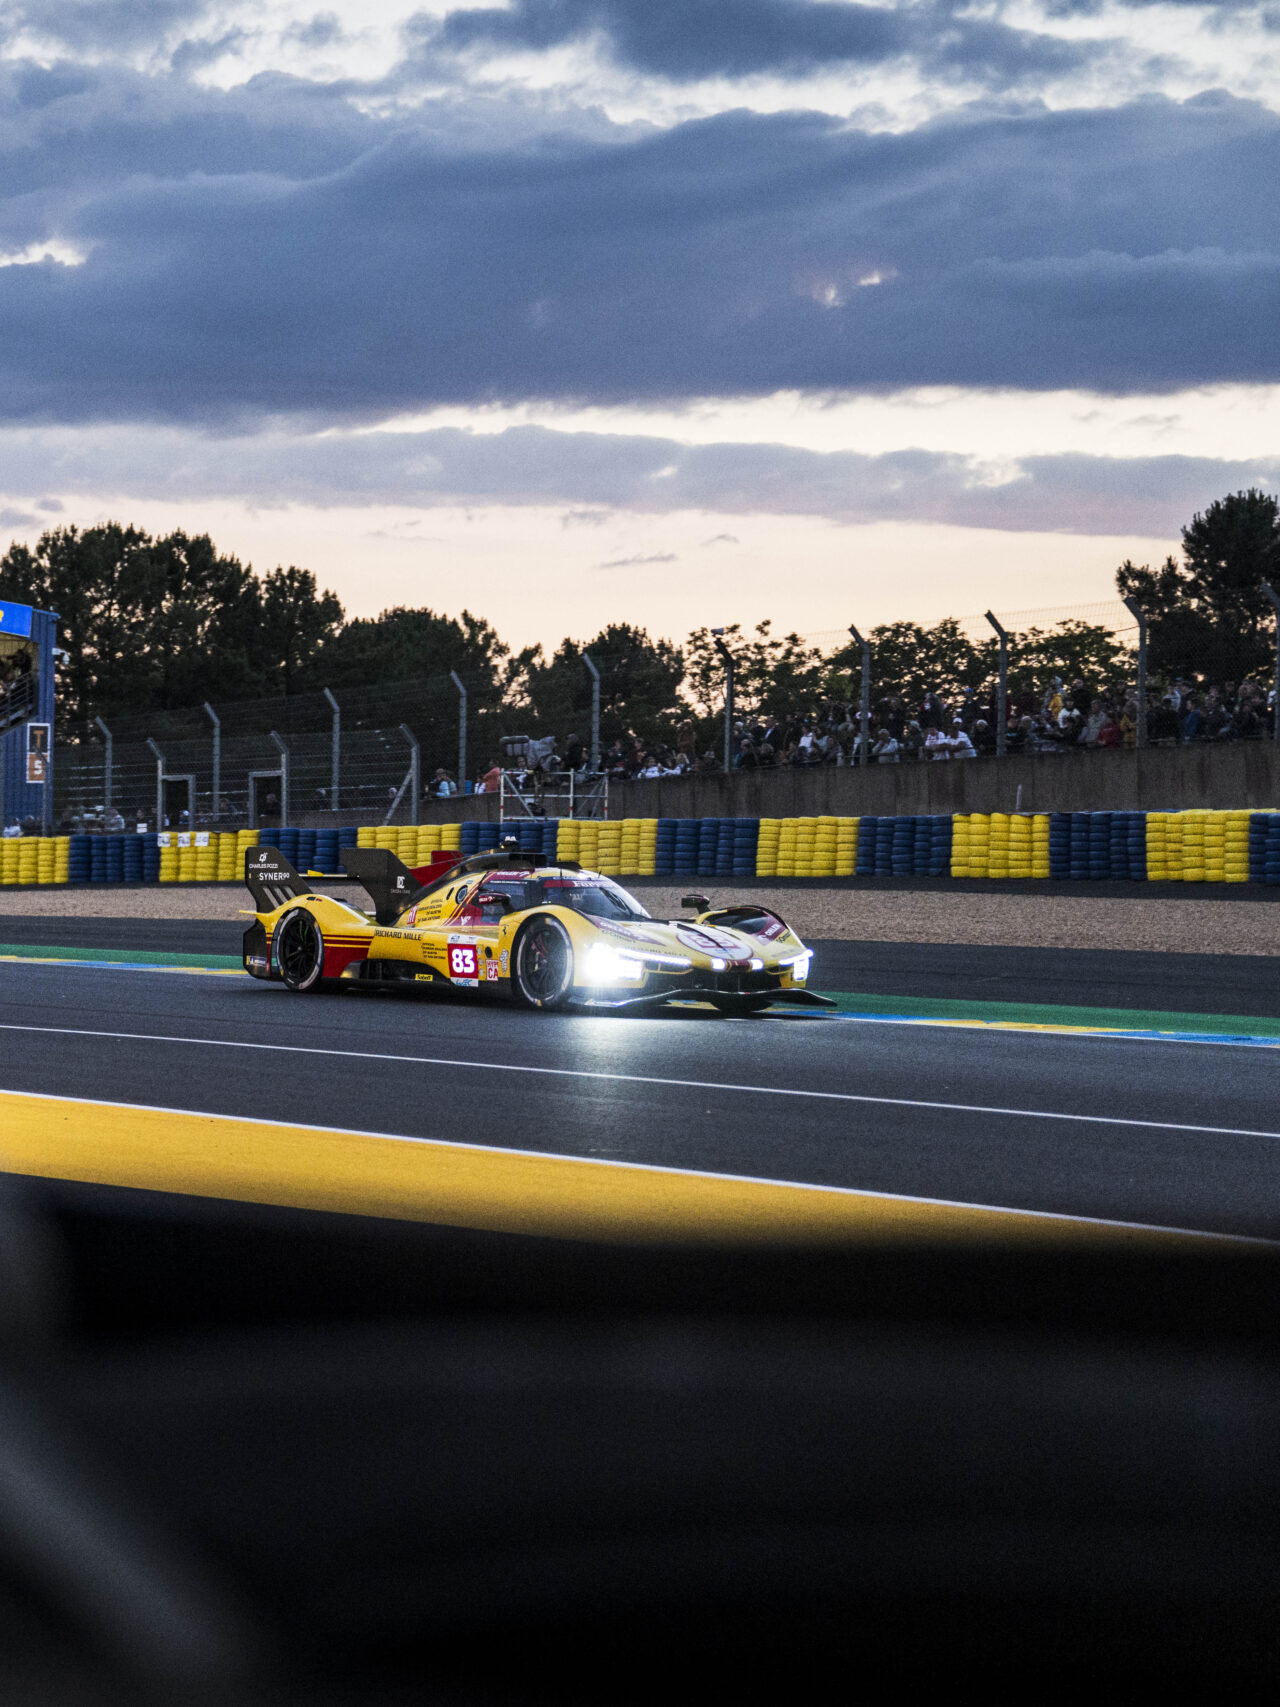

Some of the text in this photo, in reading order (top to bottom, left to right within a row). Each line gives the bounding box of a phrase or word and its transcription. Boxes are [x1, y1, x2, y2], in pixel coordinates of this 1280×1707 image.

[375, 930, 422, 941] RICHARD MILLE
[451, 947, 476, 974] 83
